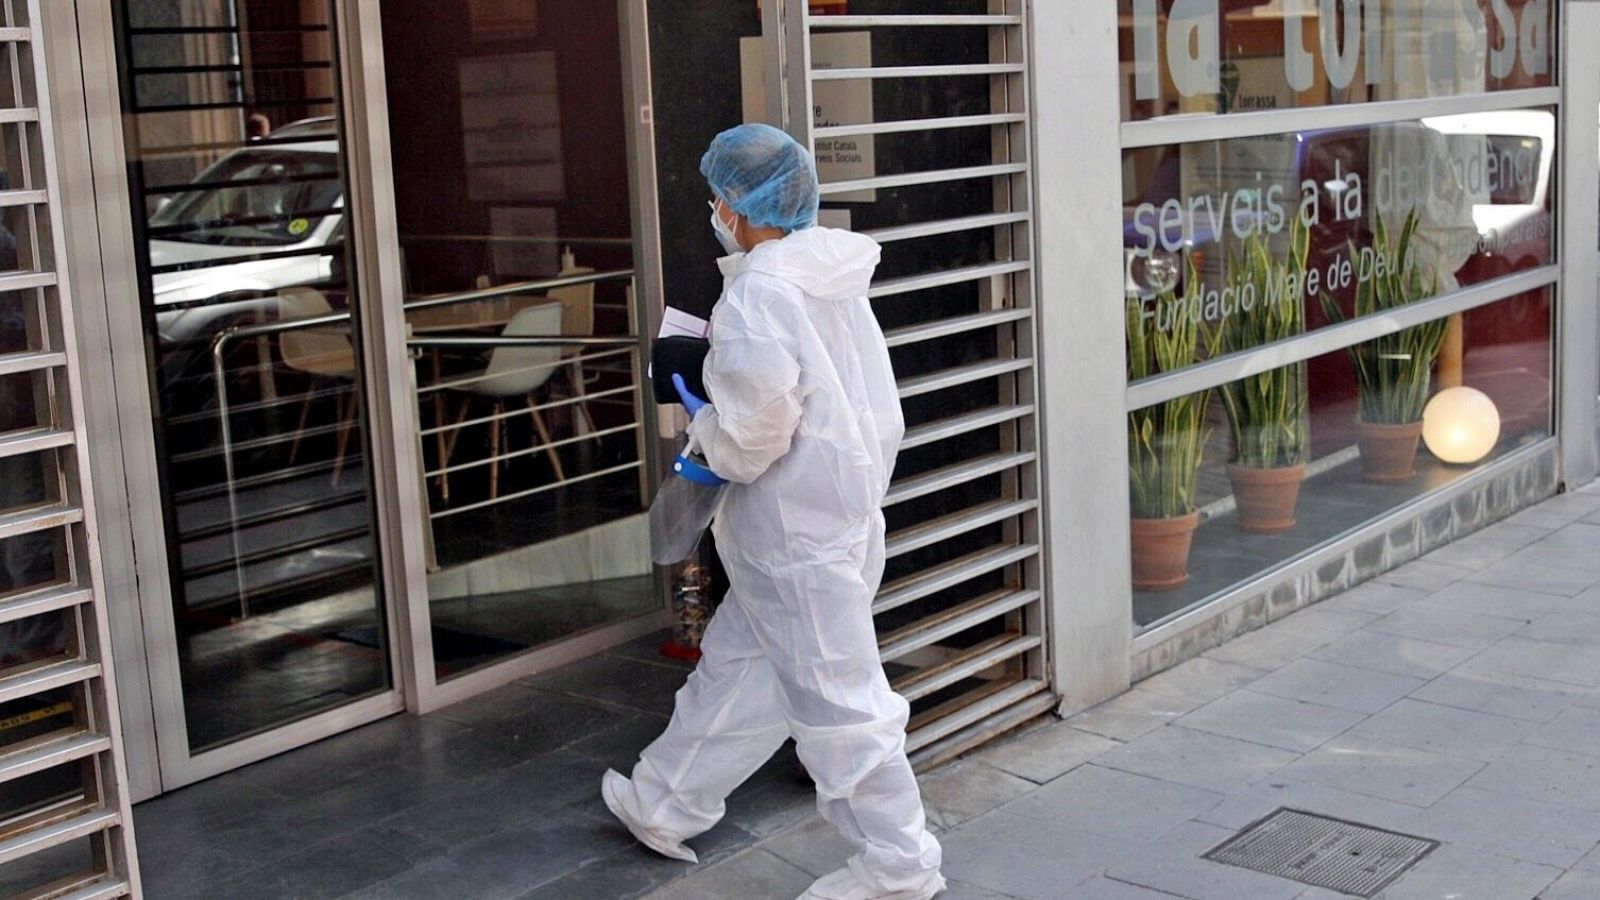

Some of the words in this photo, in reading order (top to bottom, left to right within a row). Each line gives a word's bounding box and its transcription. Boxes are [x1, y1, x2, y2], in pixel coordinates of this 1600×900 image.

[1134, 171, 1284, 258] serveis
[1301, 178, 1319, 228] a
[1336, 158, 1362, 221] la
[1140, 272, 1256, 339] Fundació
[1264, 266, 1320, 307] Mare
[1327, 253, 1352, 291] de
